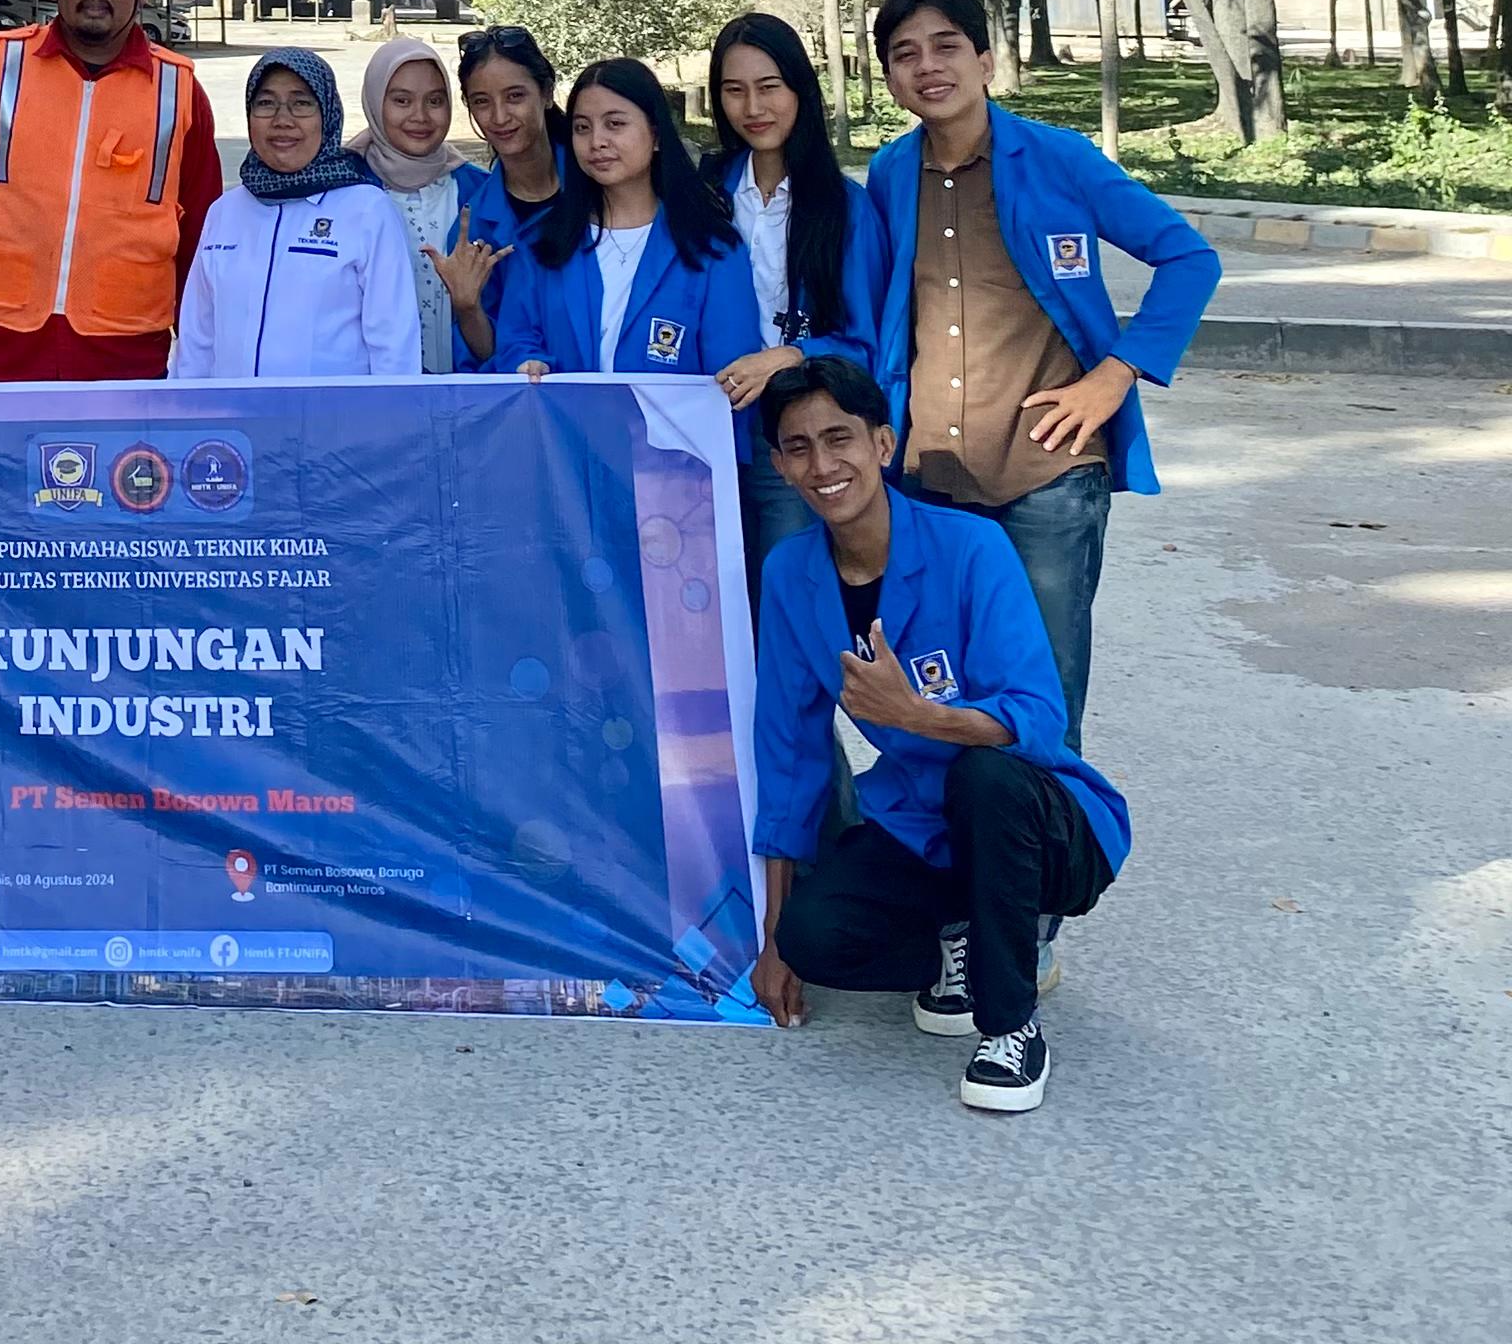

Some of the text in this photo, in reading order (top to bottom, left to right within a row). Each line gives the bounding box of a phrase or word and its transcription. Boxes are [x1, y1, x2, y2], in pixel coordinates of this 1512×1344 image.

[69, 540, 191, 558] MAHASISWA
[194, 539, 267, 557] TEKNIK
[270, 539, 329, 556] KIMIA
[60, 572, 132, 589] TEKNIK
[135, 571, 264, 588] UNIVERSITAS
[267, 570, 332, 587] FAJAR
[19, 696, 274, 737] INDUSTRI
[11, 786, 355, 813] PT Semen Bosowa Maros
[16, 874, 31, 886] 08
[34, 874, 83, 889] Agustus
[85, 874, 115, 886] 2024
[264, 864, 425, 881] PT Semen Bosowa, Baruga
[266, 881, 386, 897] Bantimurung Maros
[243, 947, 275, 958] Hmtk
